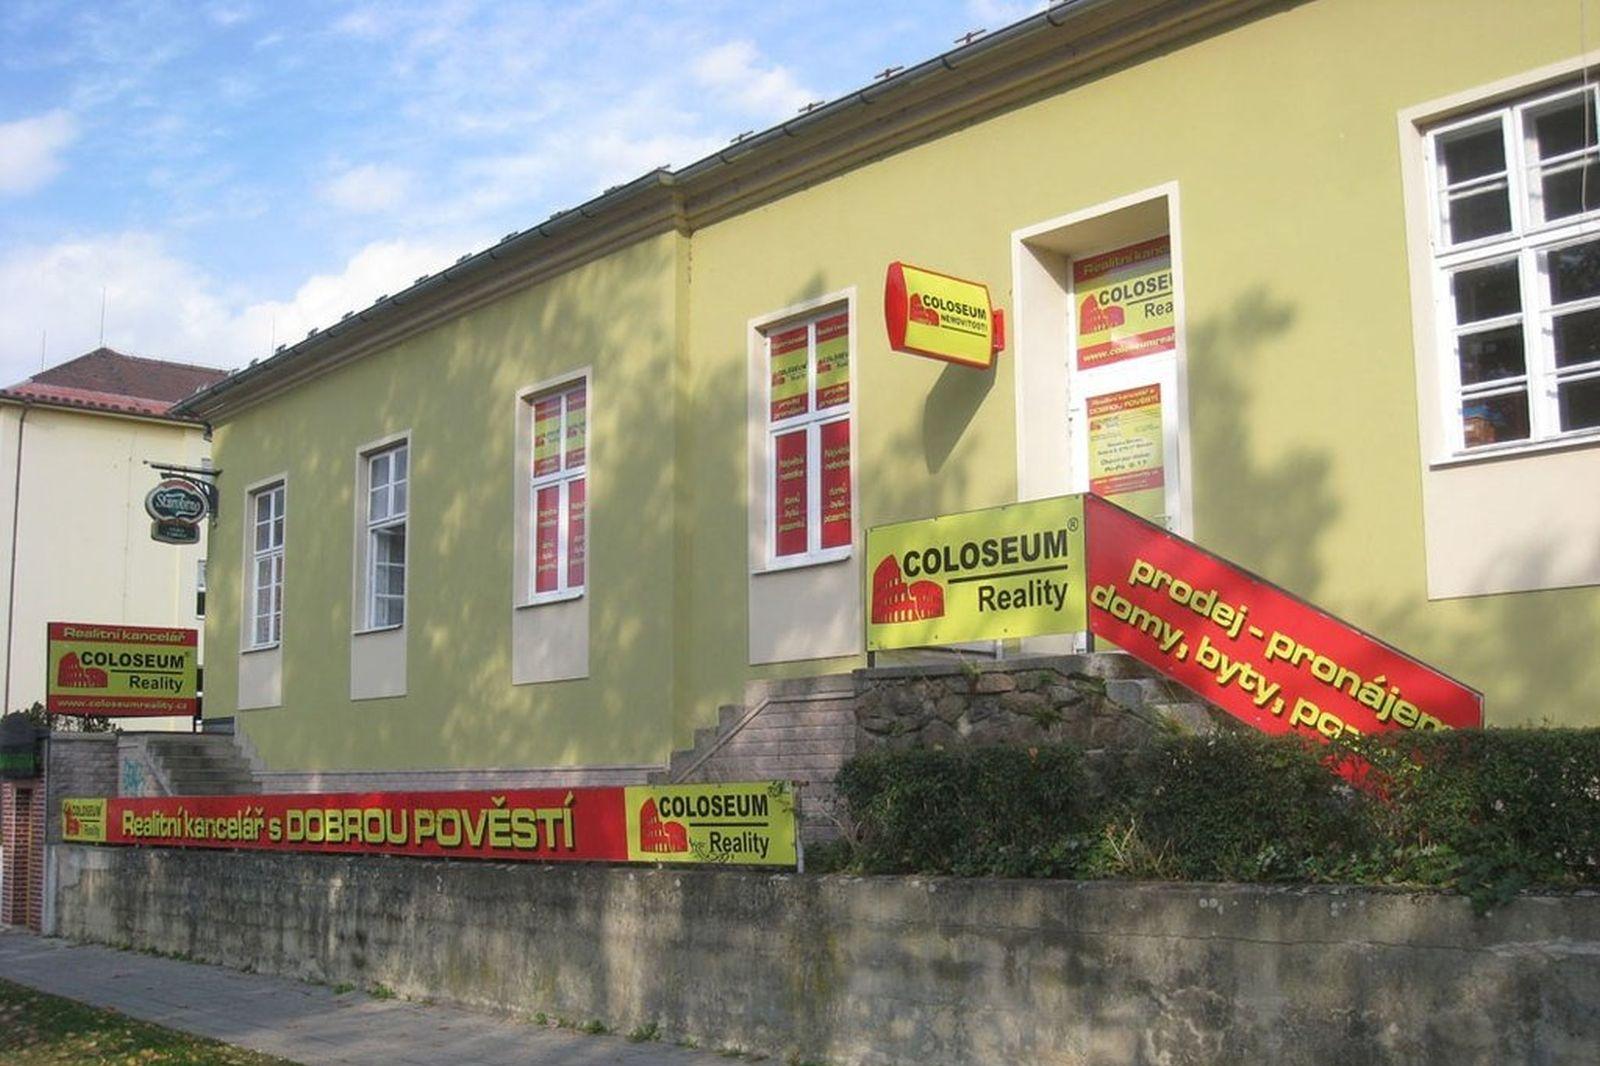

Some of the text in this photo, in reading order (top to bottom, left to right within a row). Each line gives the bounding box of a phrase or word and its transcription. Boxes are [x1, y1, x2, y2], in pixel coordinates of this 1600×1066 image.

[1098, 272, 1173, 306] COLOSE
[922, 294, 987, 320] COLOSEUM
[903, 529, 1068, 577] COLOSEUM
[978, 579, 1069, 612] Reality
[1128, 557, 1248, 640] prodej
[63, 627, 187, 642] Realitní kancelář
[1090, 584, 1189, 660] domy,
[1195, 635, 1286, 715] byty,
[81, 651, 185, 669] COLOSEUM
[129, 676, 184, 693] Reality
[122, 790, 575, 849] Realitní kancelář s DOBROU POVĚSTÍ
[659, 794, 769, 817] COLOSEUM
[709, 831, 770, 859] Reality
